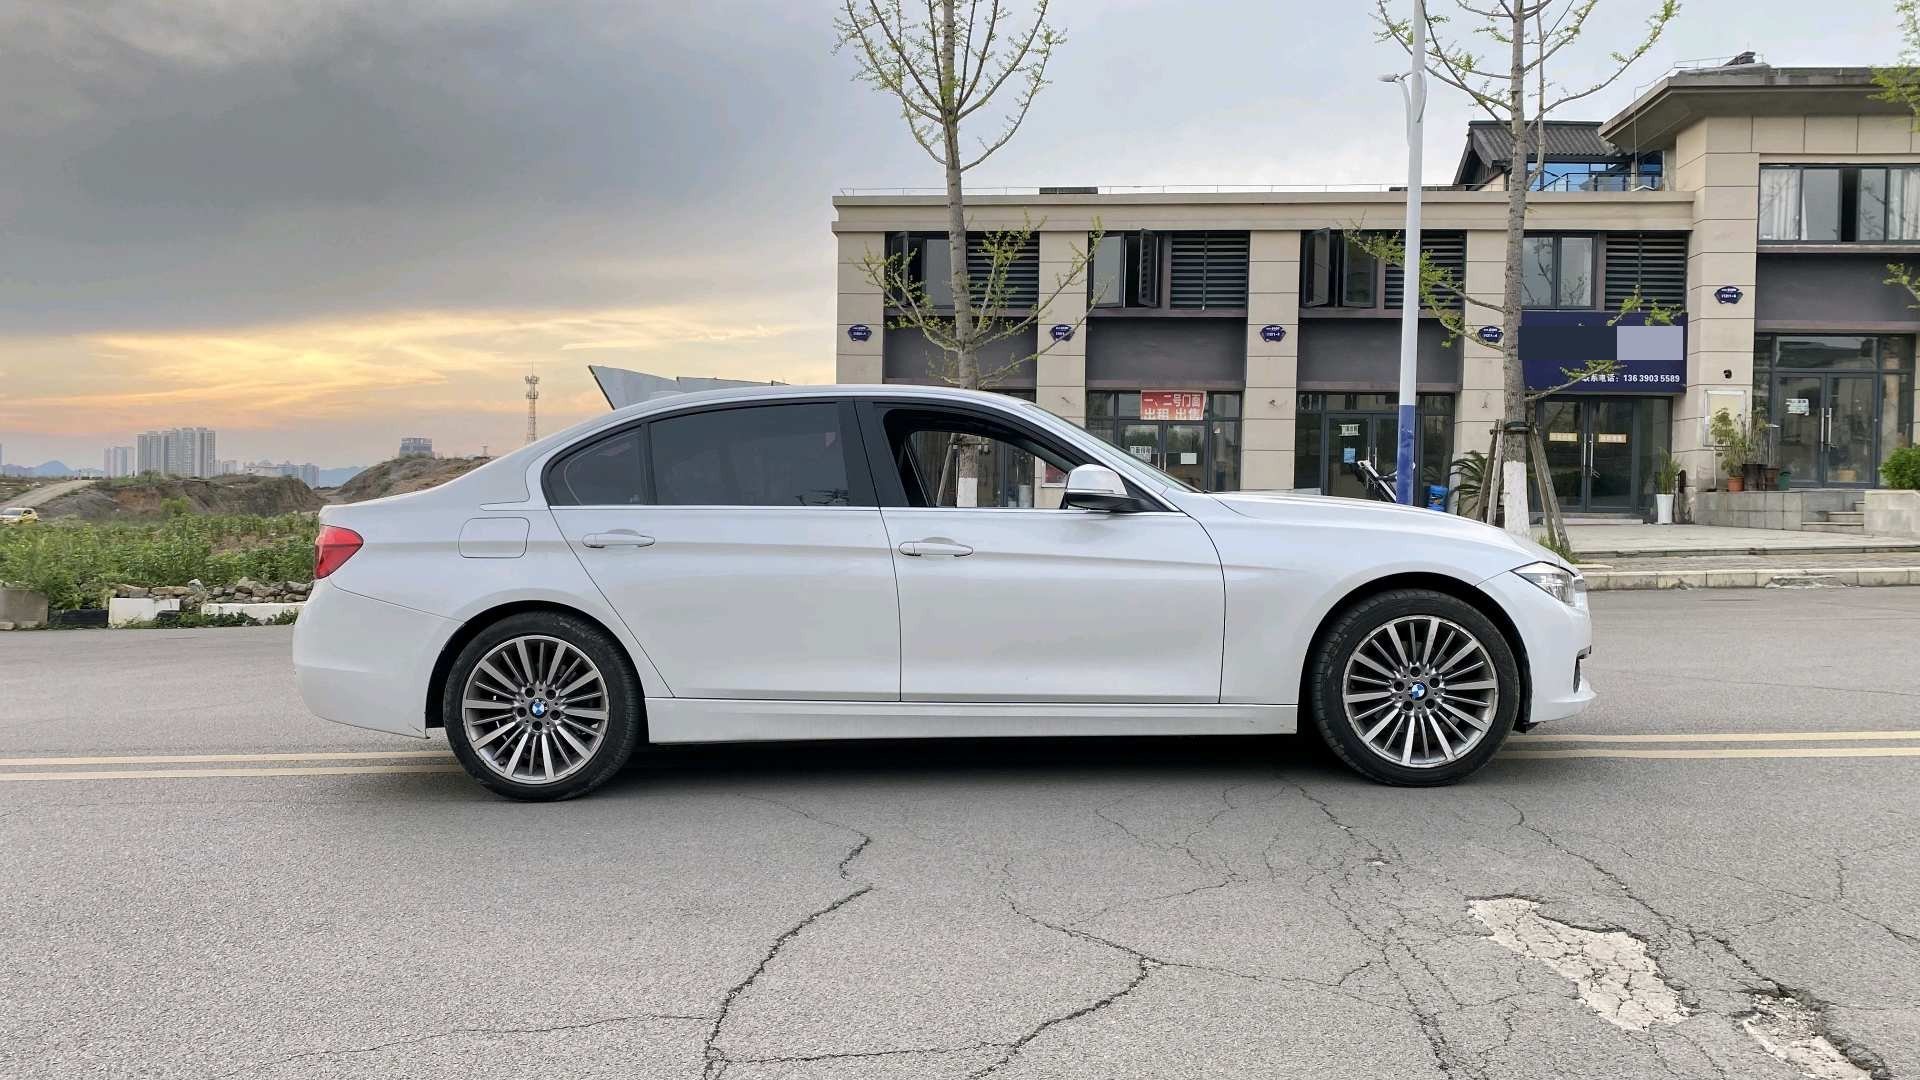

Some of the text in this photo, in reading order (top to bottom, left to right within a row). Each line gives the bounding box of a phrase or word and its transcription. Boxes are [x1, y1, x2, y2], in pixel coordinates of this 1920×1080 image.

[1623, 374, 1638, 383] 136
[1639, 374, 1659, 383] 3903
[1660, 374, 1680, 383] 5589
